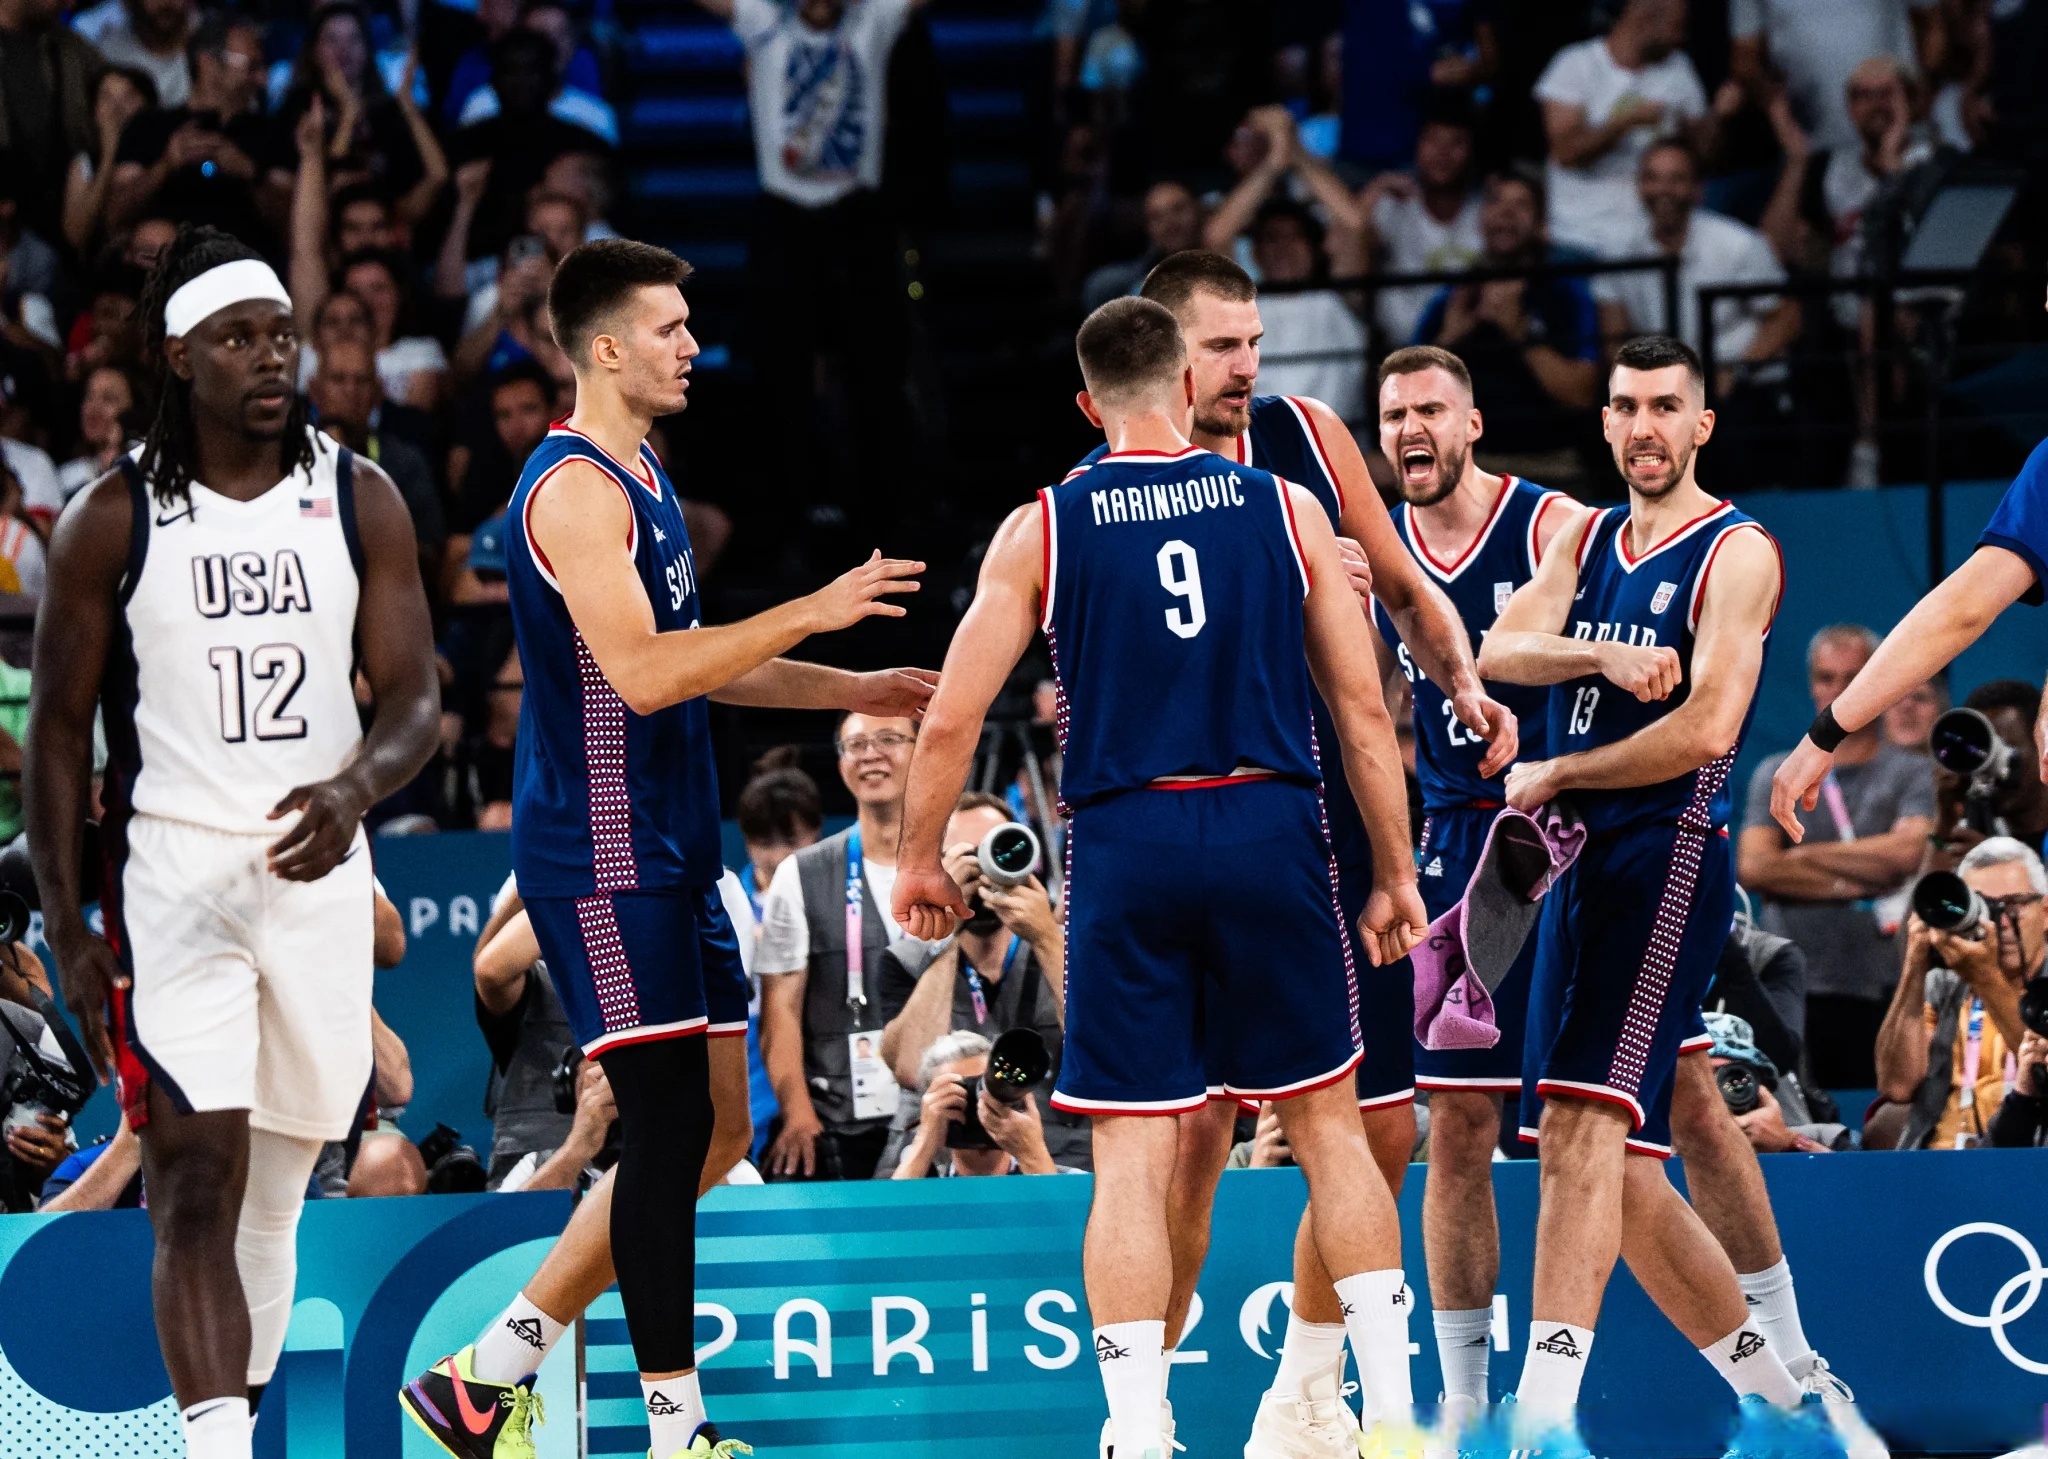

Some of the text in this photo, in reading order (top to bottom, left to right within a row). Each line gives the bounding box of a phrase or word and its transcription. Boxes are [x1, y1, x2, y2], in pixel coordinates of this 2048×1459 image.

[1091, 471, 1244, 525] MARINKOVIĆ
[192, 549, 311, 618] USA
[1156, 540, 1206, 639] 9
[209, 643, 307, 743] 12
[1568, 686, 1600, 735] 13
[409, 894, 497, 938] PA
[506, 1318, 547, 1351] PEAK
[1097, 1347, 1131, 1363] EAK
[1535, 1341, 1584, 1360] PEAK
[1729, 1334, 1767, 1363] PEAK
